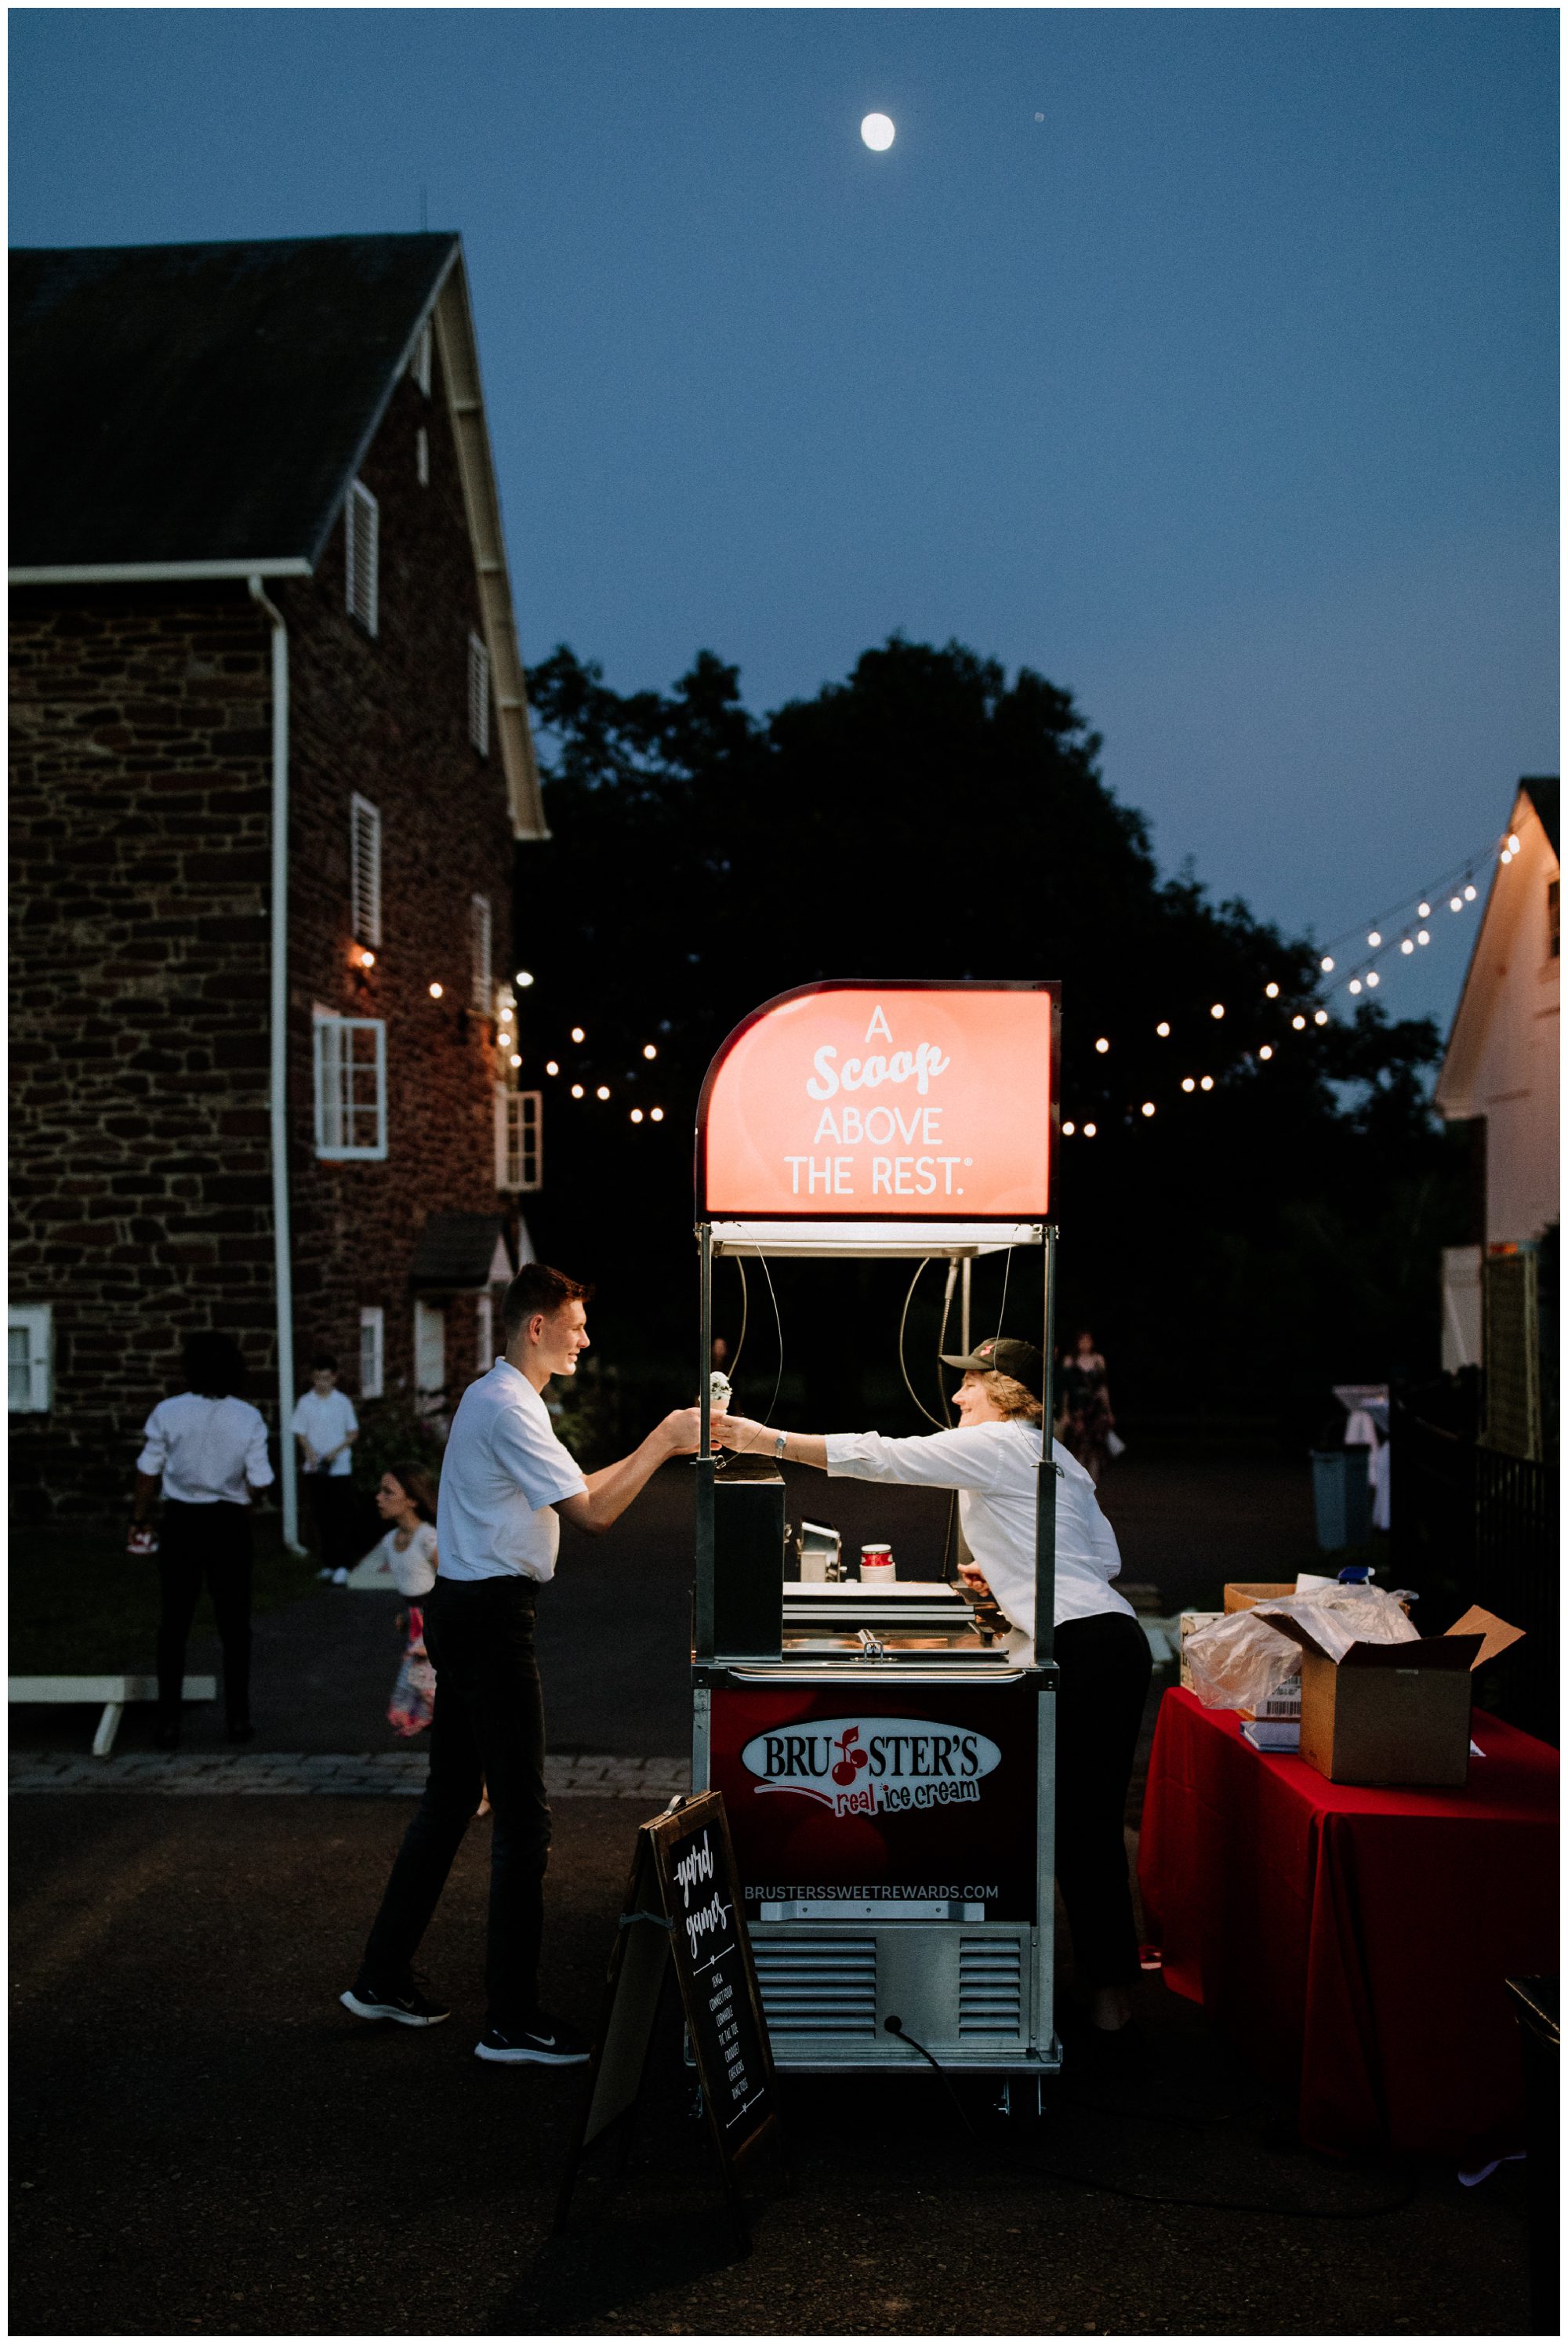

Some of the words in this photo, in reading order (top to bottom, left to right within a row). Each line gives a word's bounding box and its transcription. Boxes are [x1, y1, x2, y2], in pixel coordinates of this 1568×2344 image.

[864, 1004, 893, 1043] A
[806, 1042, 950, 1101] Scoop
[814, 1106, 943, 1145] ABOVE
[783, 1156, 854, 1195] THE
[837, 1783, 875, 1812] real
[880, 1783, 911, 1809] ice
[915, 1780, 978, 1807] cream
[673, 1829, 714, 1908] yard
[745, 1886, 1000, 1900] BRUSTERSSWEETREWARDS.COM
[685, 1892, 733, 1959] games
[709, 1990, 724, 2012] CONNECT
[723, 1984, 734, 2001] FOUR
[724, 2027, 732, 2041] TAC
[730, 2022, 739, 2035] TOE
